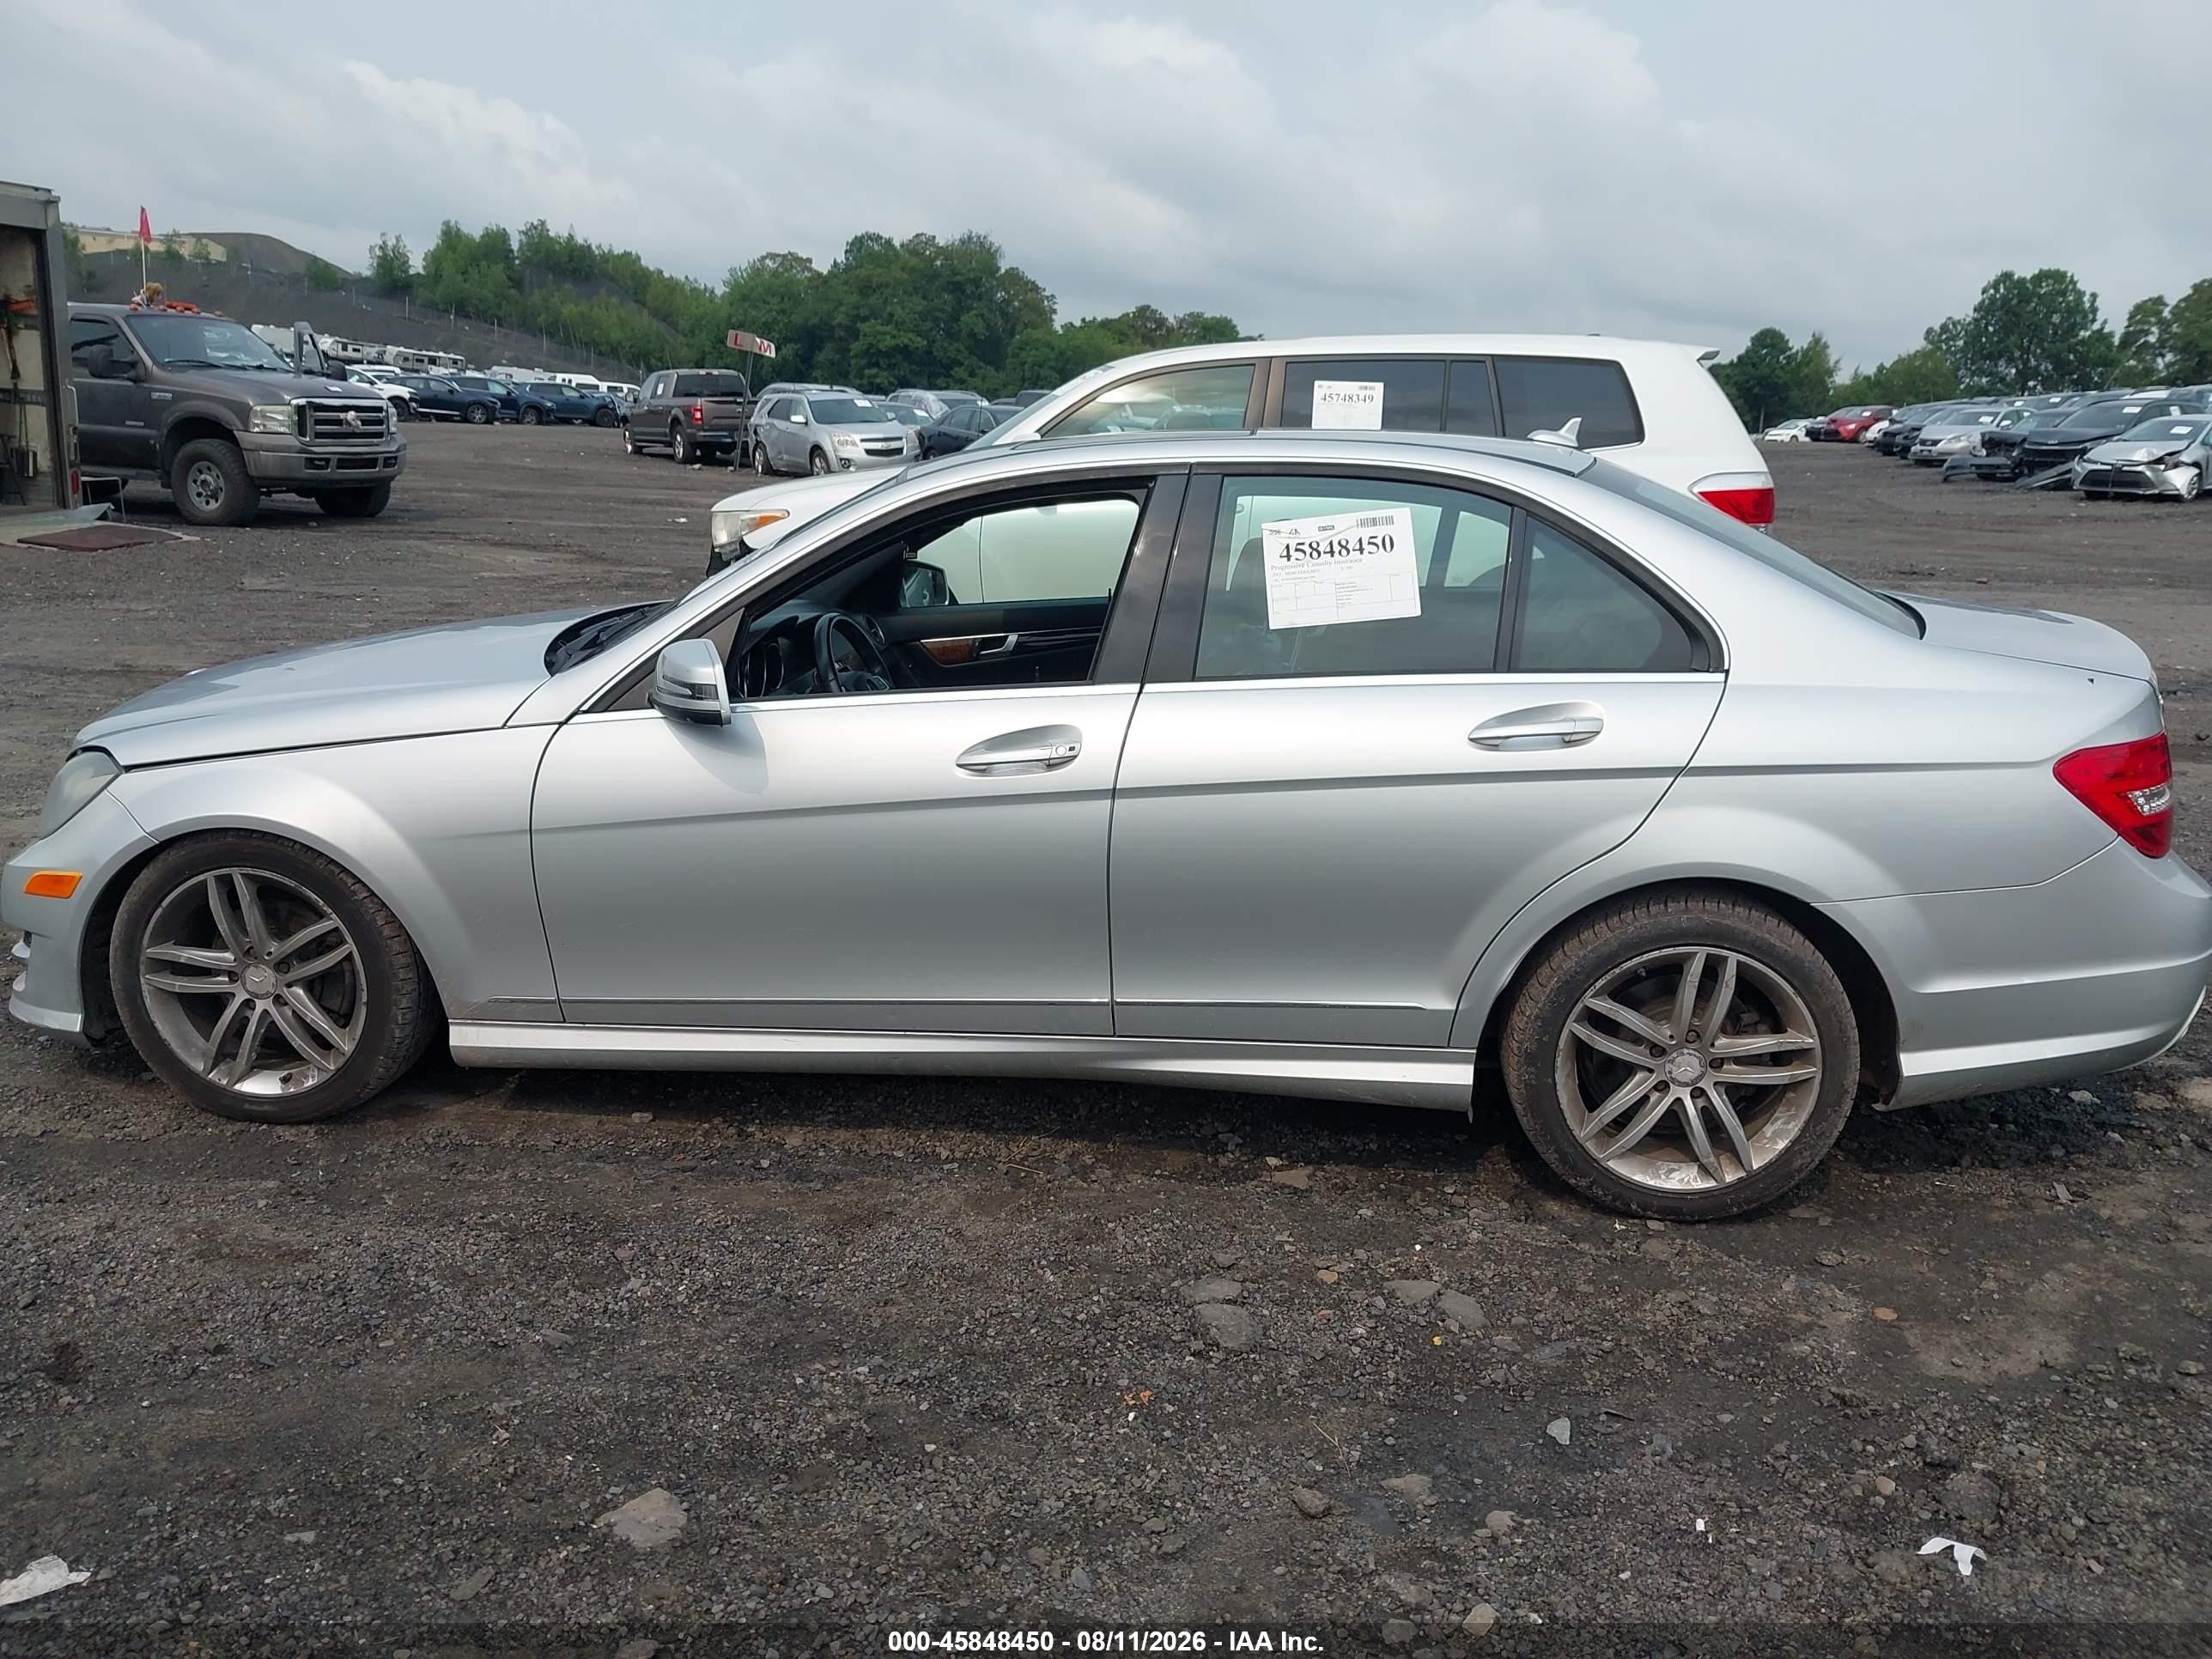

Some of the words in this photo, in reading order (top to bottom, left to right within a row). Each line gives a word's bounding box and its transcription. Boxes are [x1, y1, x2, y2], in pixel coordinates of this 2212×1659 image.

[733, 332, 743, 348] L
[758, 339, 772, 355] M
[1320, 392, 1375, 404] 45748349
[1279, 533, 1395, 562] 45848450
